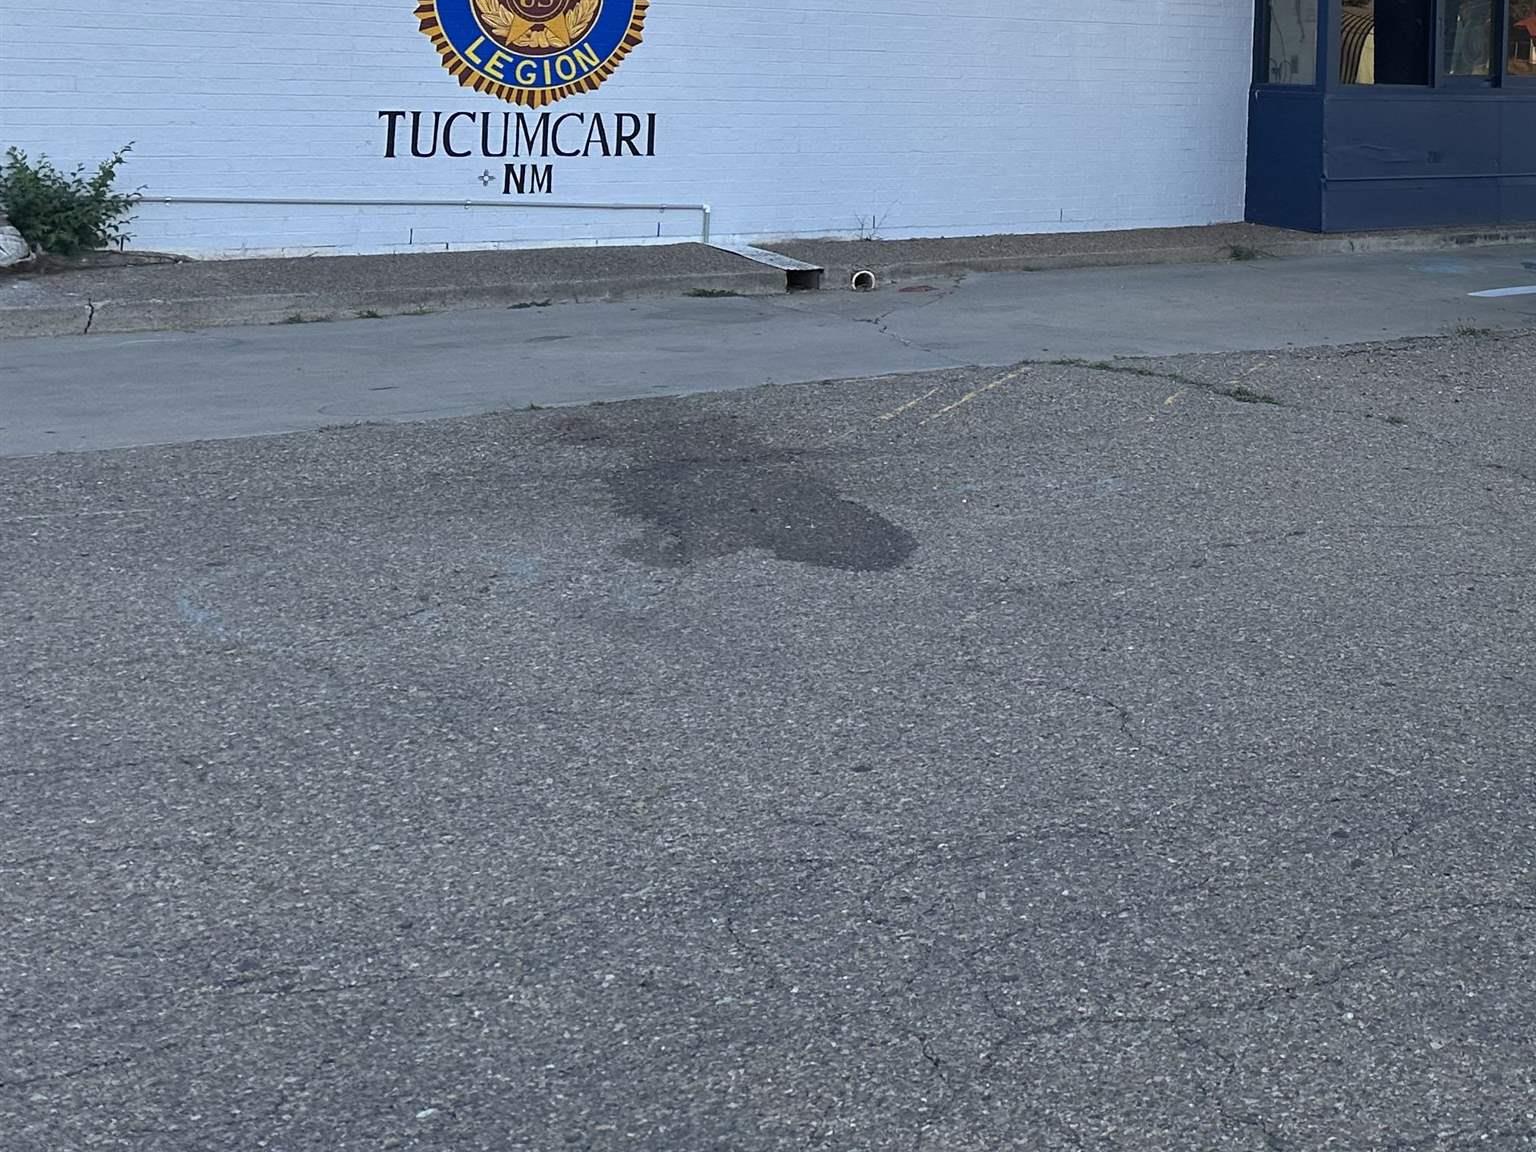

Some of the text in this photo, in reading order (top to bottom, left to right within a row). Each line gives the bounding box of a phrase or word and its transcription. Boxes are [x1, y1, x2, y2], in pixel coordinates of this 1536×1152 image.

[464, 35, 600, 85] LEGION
[378, 110, 657, 158] TUCUMCARI
[502, 163, 553, 195] NM
